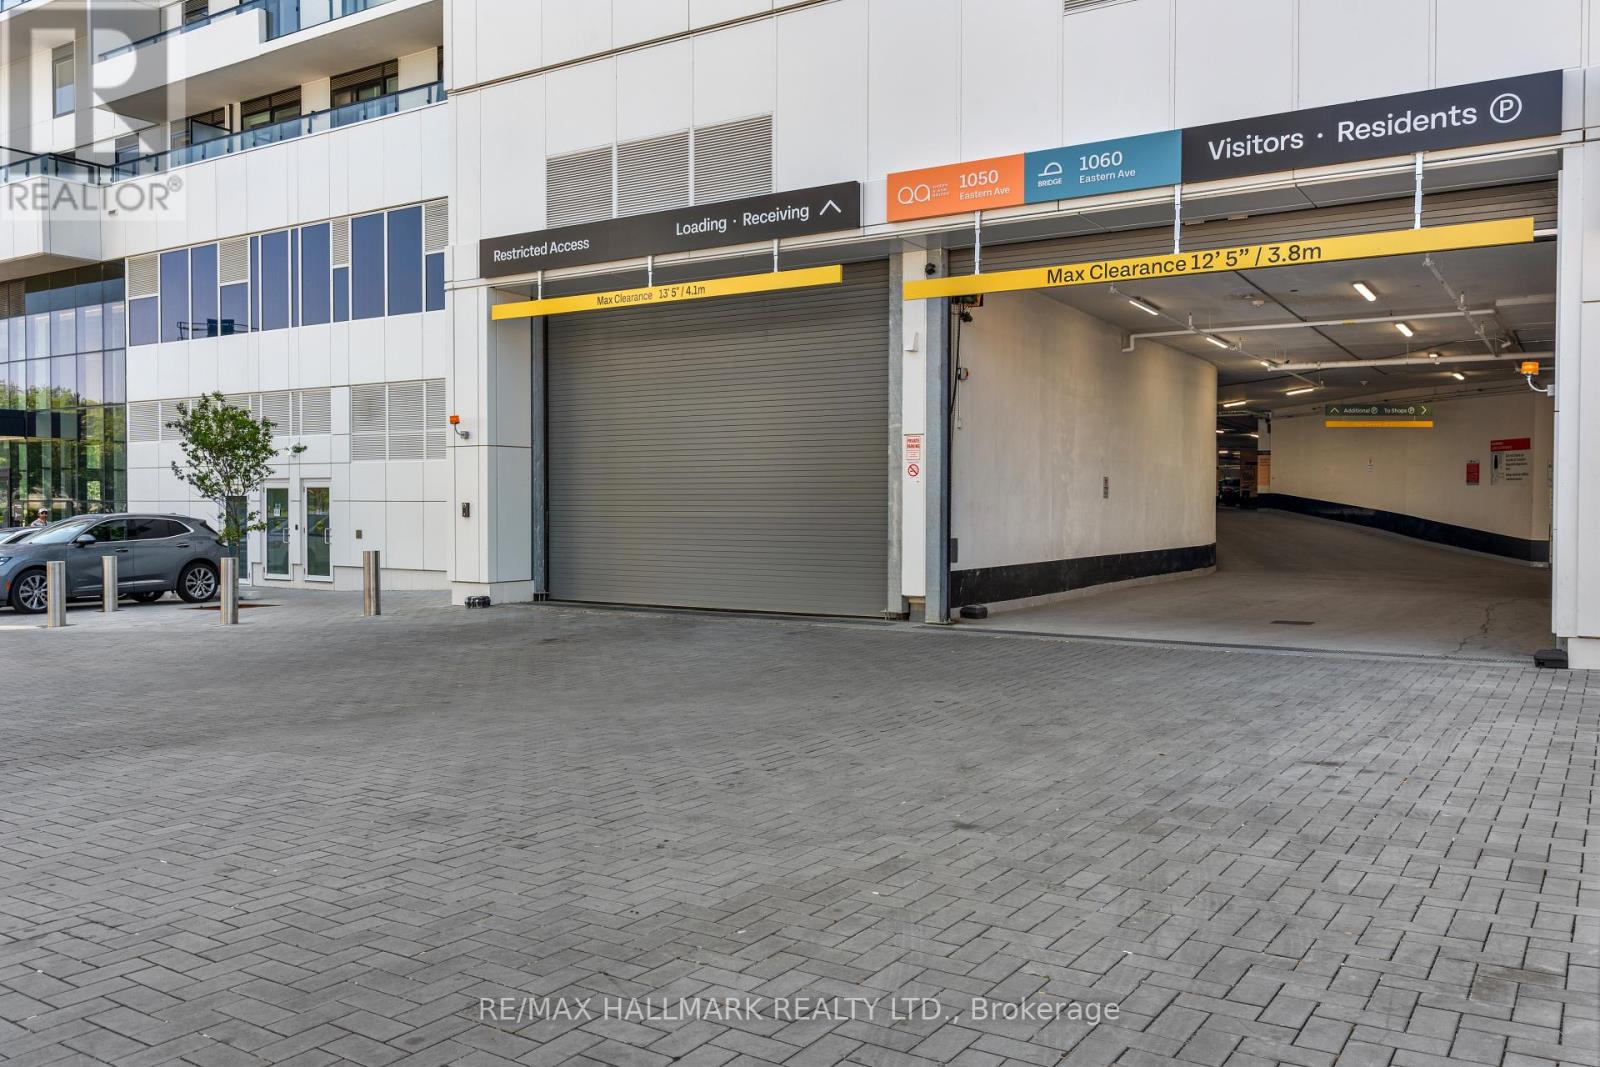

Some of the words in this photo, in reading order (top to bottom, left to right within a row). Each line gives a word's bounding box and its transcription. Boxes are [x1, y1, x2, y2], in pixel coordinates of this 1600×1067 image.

[1208, 130, 1304, 160] Visitors
[1337, 104, 1478, 143] Residents
[1079, 151, 1123, 171] 1060
[959, 169, 999, 188] 1050
[1037, 178, 1063, 187] BRIDGE
[1079, 172, 1116, 184] Eastern
[1117, 169, 1136, 178] Ave
[959, 189, 992, 200] Eastern
[993, 187, 1010, 196] Ave
[676, 218, 727, 236] Loading
[743, 204, 810, 227] Receiving
[493, 242, 548, 263] Restricted
[549, 237, 590, 255] Access
[1047, 267, 1085, 284] Max
[1089, 257, 1187, 281] Clearance
[1268, 243, 1322, 263] 3.8m
[596, 296, 613, 306] Max
[614, 292, 653, 304] Clearance
[686, 285, 706, 296] 4.1m
